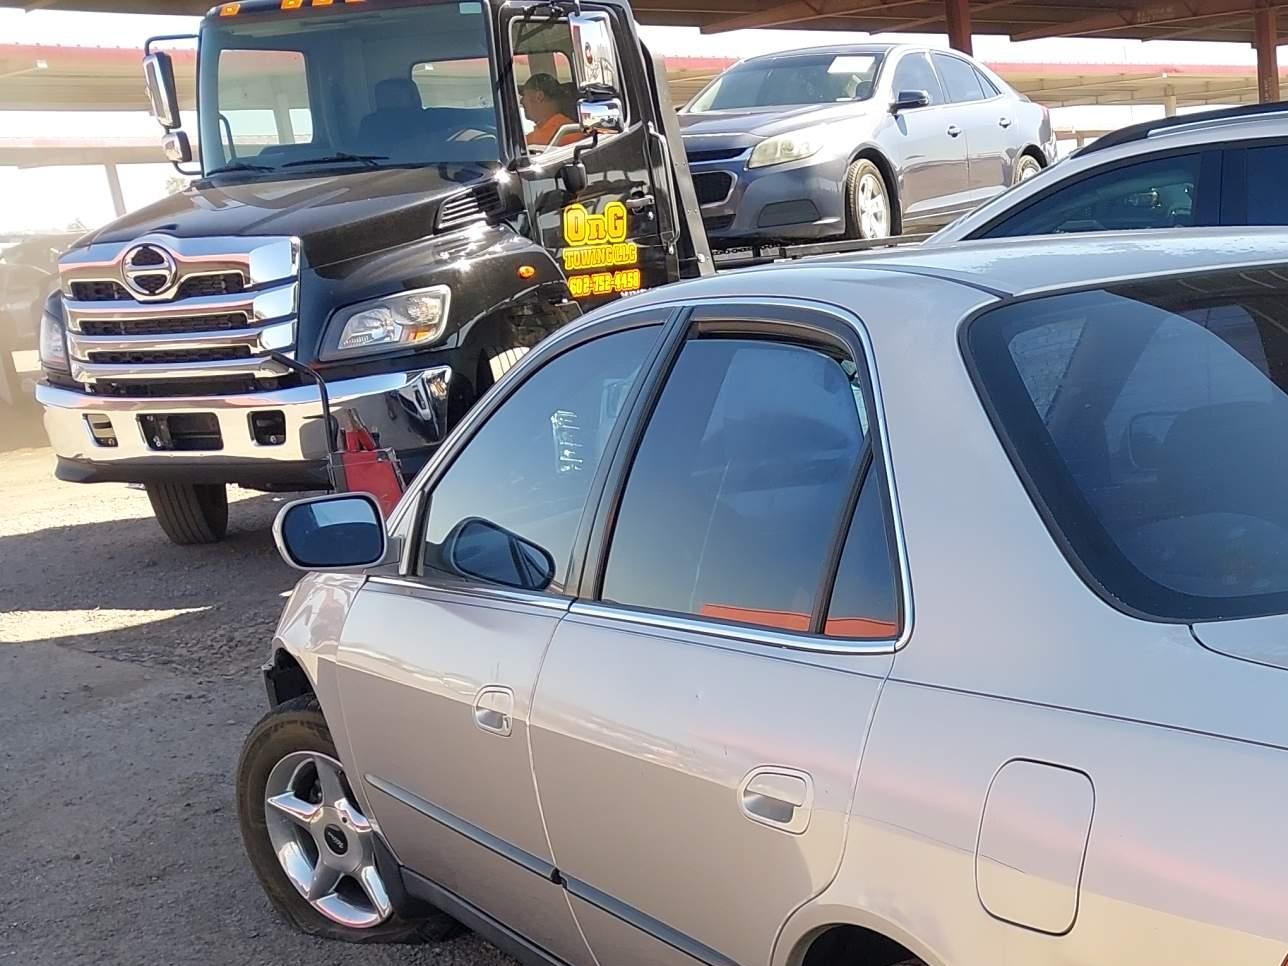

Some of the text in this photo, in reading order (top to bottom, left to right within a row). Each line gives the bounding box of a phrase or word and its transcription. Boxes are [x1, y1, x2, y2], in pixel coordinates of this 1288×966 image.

[564, 202, 627, 246] OnG
[563, 242, 638, 270] TOWING LLC
